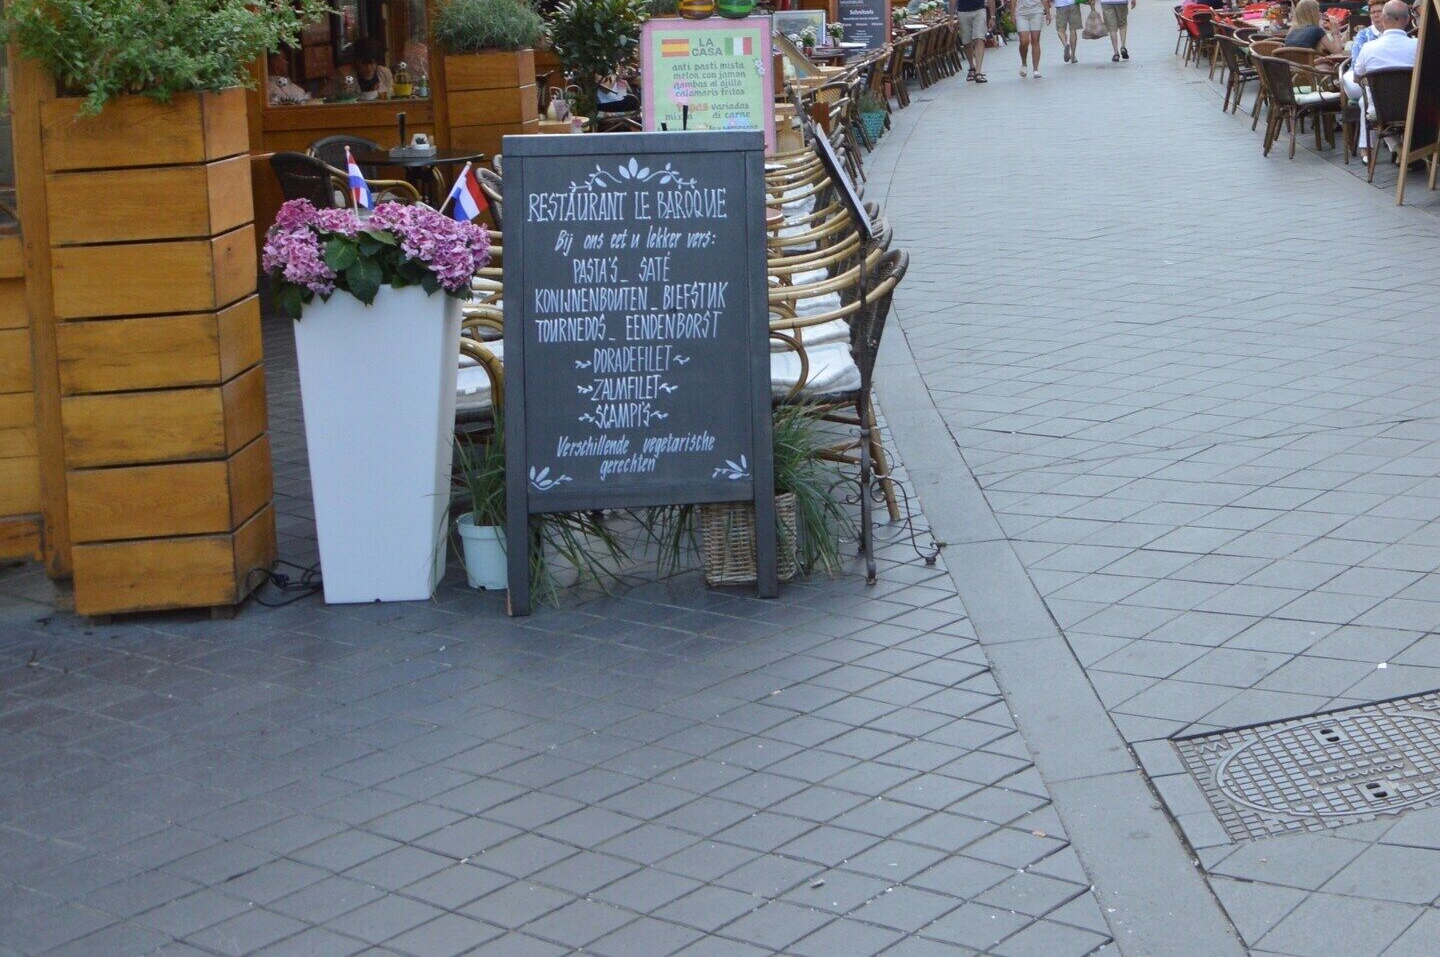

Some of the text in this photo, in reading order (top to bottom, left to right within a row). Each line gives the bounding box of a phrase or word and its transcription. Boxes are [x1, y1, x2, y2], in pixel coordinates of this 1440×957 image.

[691, 47, 723, 57] CASA
[699, 38, 714, 47] LA
[672, 61, 744, 72] anti pasti mista
[673, 71, 699, 80] melon
[673, 81, 708, 90] gambas
[675, 88, 746, 98] calamaris fritos
[665, 112, 693, 121] mixa
[725, 111, 751, 119] carne
[676, 102, 750, 113] tpas variadas
[527, 187, 728, 222] RESTAURANT LE BAROQUE
[554, 224, 716, 257] Bij ons eet u lekker vers:
[573, 251, 671, 284] PASTA'S SATÉ
[535, 281, 729, 314] KONIJNENBOUTEN BIEFSTUK
[535, 310, 723, 342] TOURNEDOS EENDENBORST
[593, 345, 673, 373] DORADEFILET
[590, 374, 662, 401] ZALMFILET
[595, 401, 651, 429] SCAMPI'S
[556, 430, 716, 459] Verschillende vegetarische
[600, 453, 657, 482] gerechten
